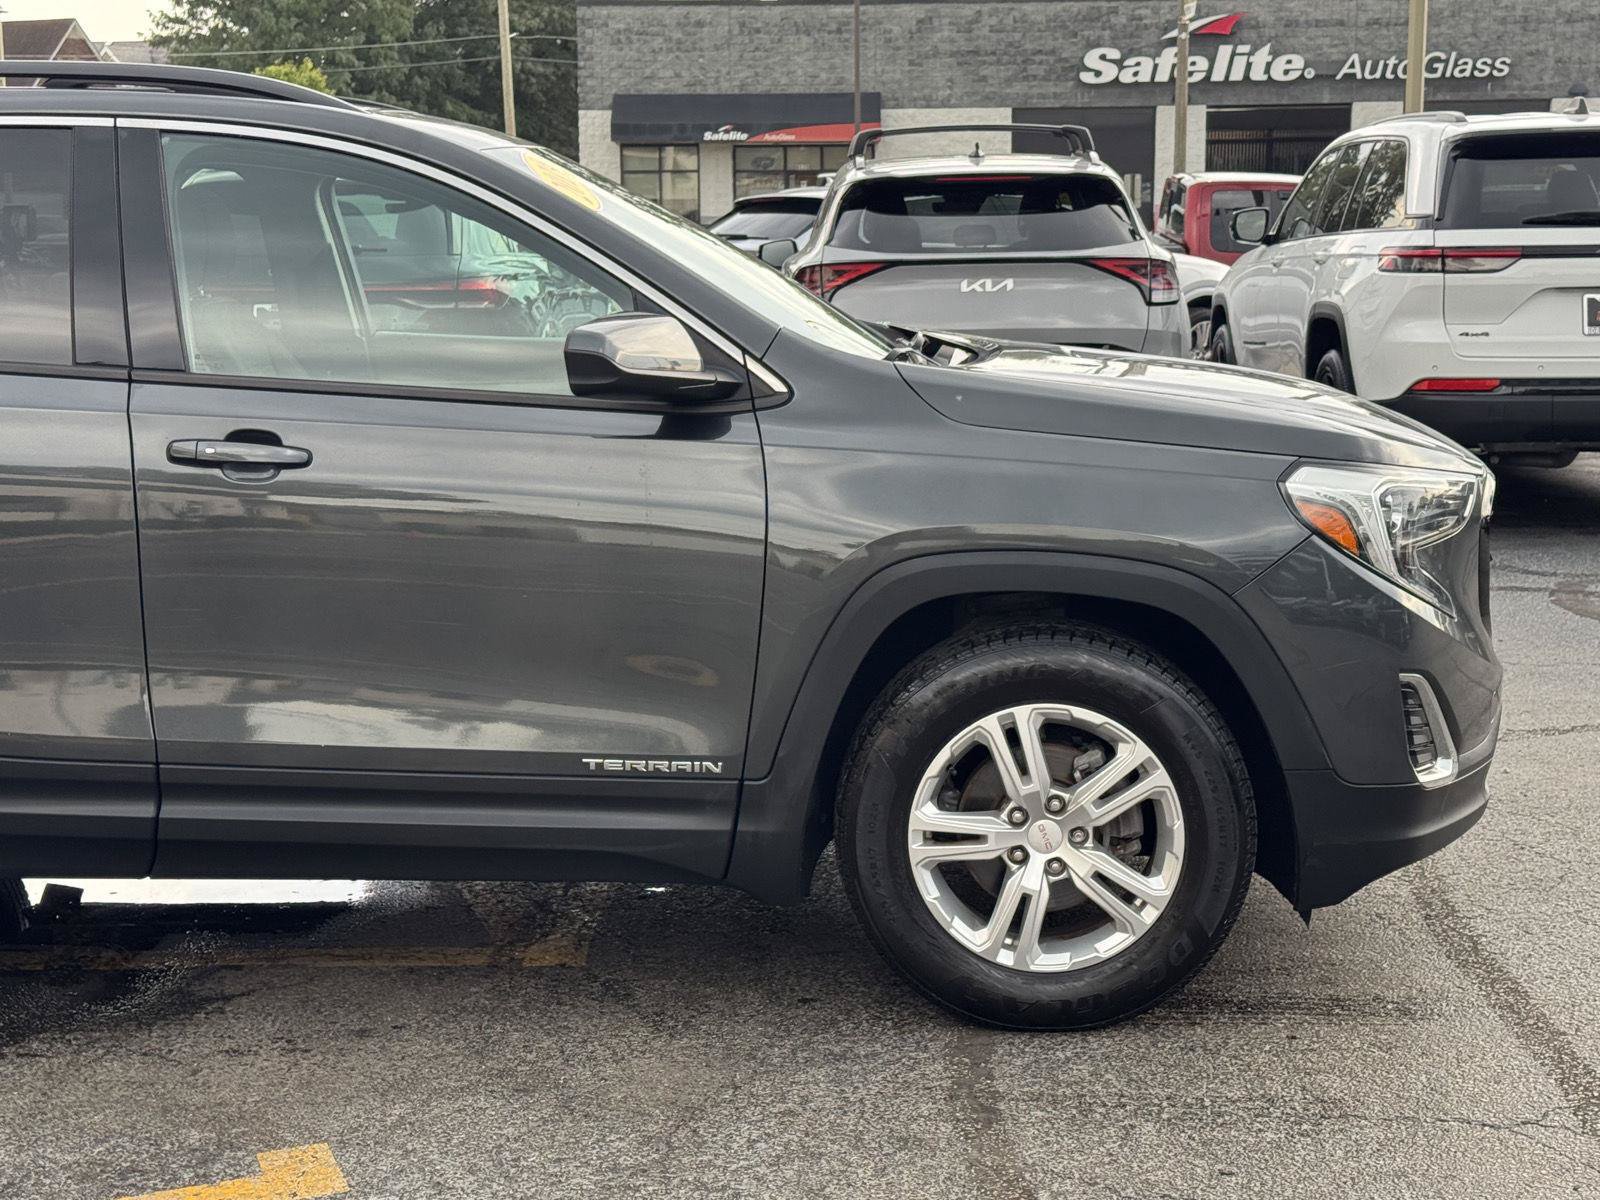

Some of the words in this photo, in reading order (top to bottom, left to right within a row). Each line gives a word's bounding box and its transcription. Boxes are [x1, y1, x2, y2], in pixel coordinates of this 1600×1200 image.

[1079, 43, 1306, 84] Safelite
[703, 131, 749, 141] Safelite
[960, 278, 1014, 292] KIA
[582, 758, 723, 774] TERRAIN
[1038, 823, 1053, 851] GMC
